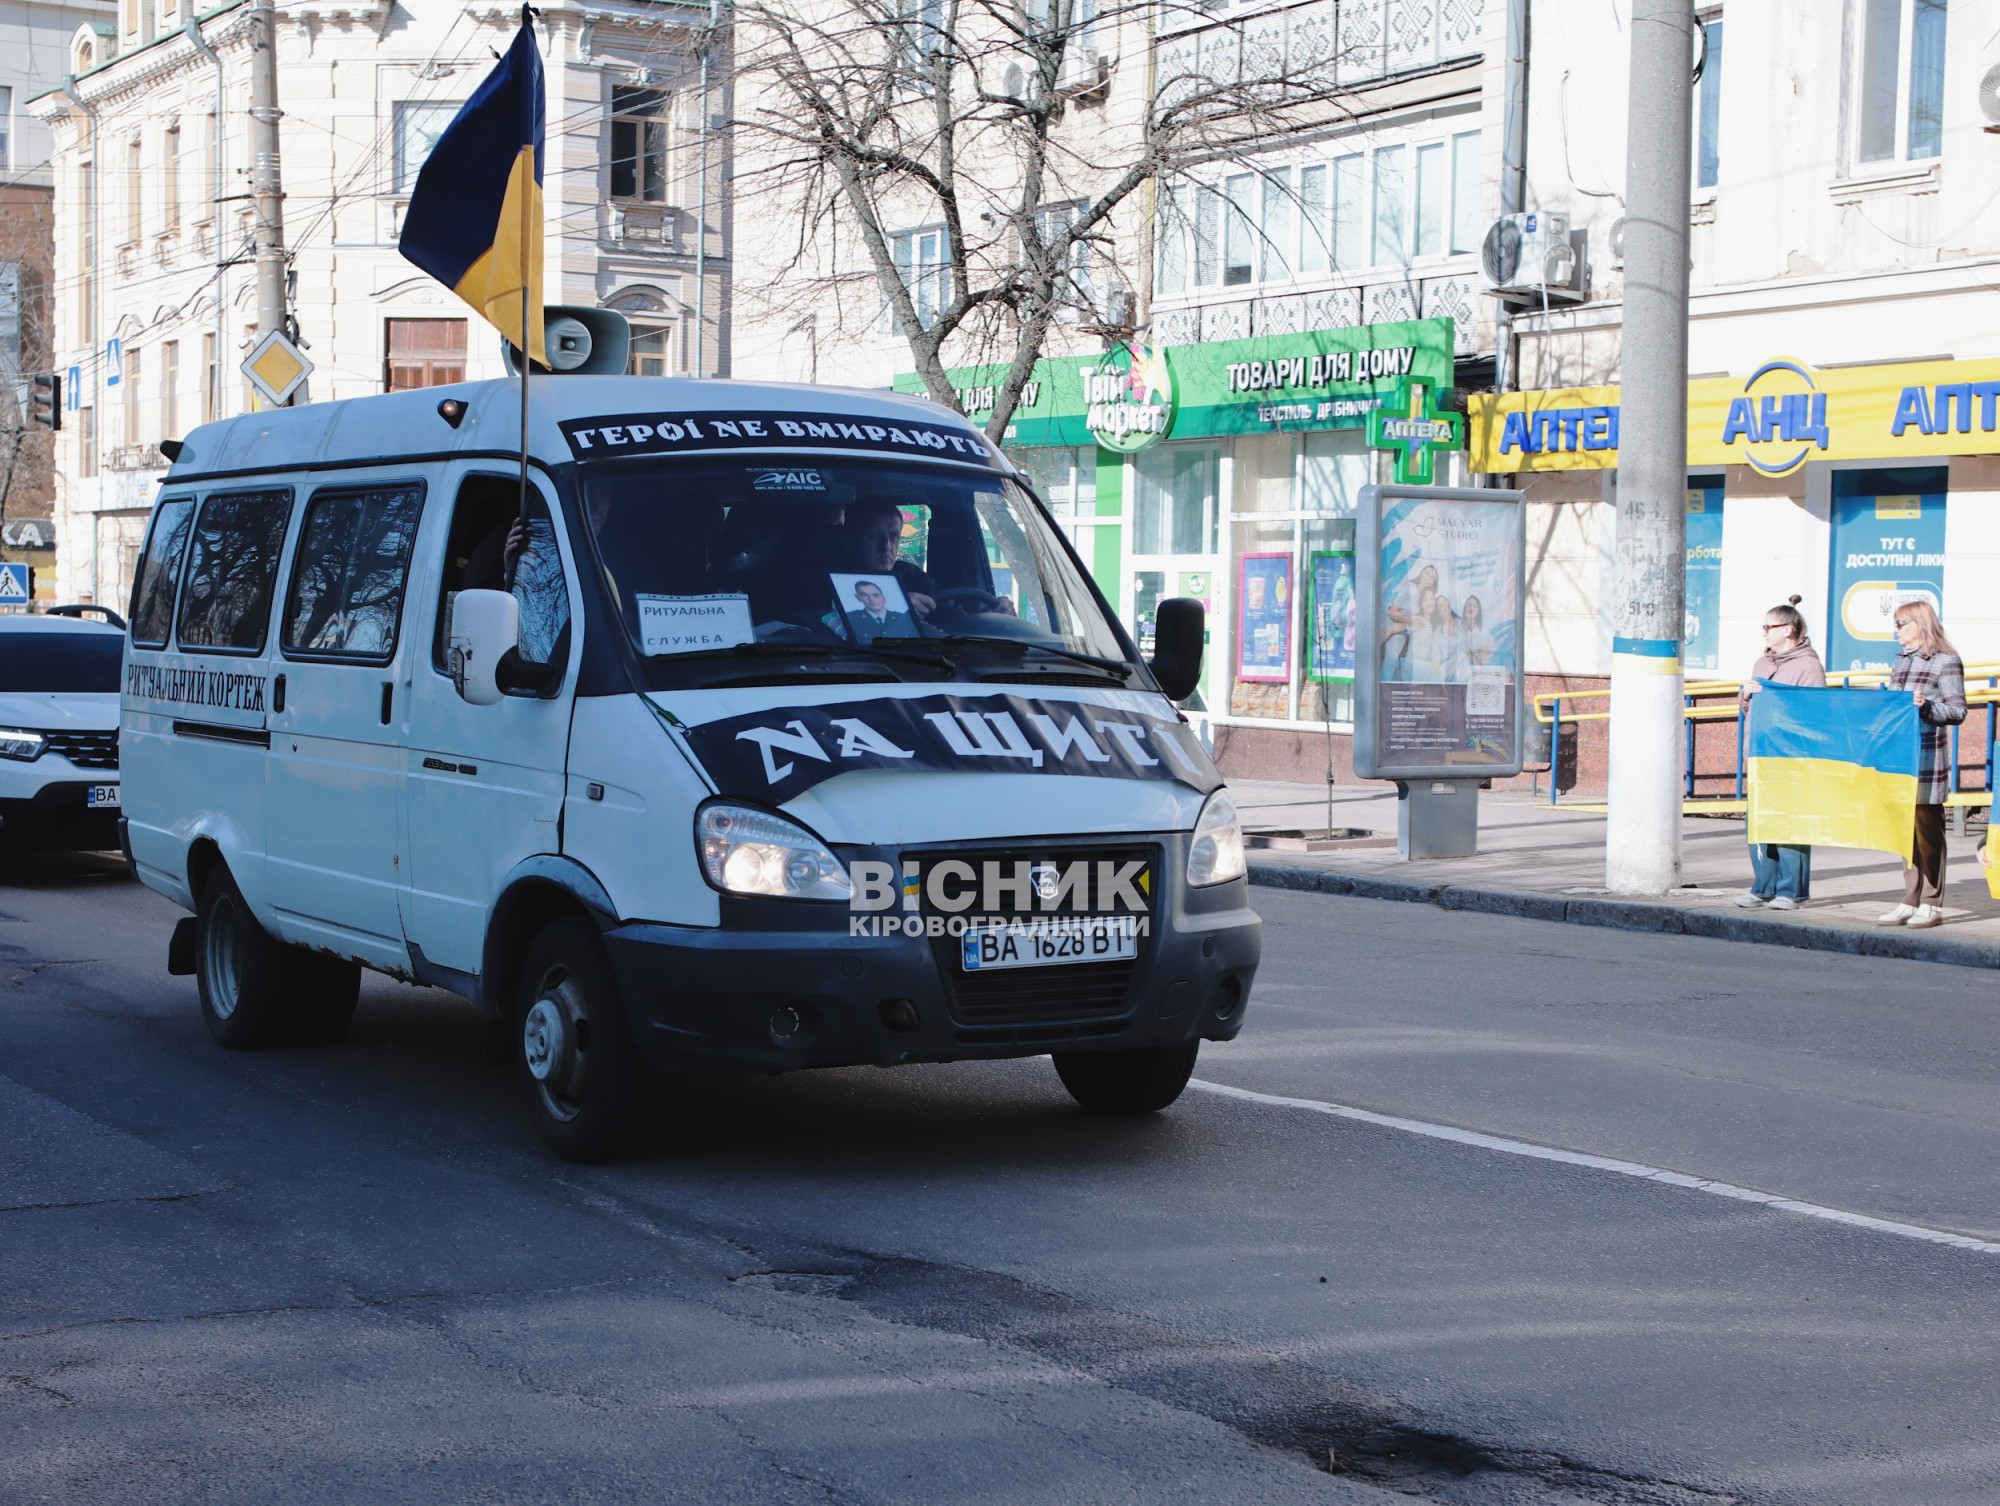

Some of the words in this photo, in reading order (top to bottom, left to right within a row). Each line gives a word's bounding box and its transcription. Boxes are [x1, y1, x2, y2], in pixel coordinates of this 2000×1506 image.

[1226, 357, 1304, 391] ТОВАРИ
[1309, 352, 1351, 387] ДЛЯ
[1356, 346, 1416, 383] ДОМУ
[1080, 364, 1125, 403] Твій
[1086, 402, 1162, 442] маркет
[1258, 404, 1312, 422] ТЕКСТИЛЬ
[1722, 392, 1829, 450] АНЦ
[572, 418, 704, 449] ГЕРОЇ
[774, 420, 993, 458] ВМИРАЮТЬ
[1384, 420, 1453, 440] АПТЕКА
[785, 472, 822, 485] AIC
[1440, 531, 1478, 540] STUDIO
[1880, 537, 1904, 550] ТУТ
[1906, 537, 1916, 550] Є
[1846, 553, 1913, 568] ДОСТУПНІ
[644, 606, 725, 616] РИТУАЛЬНА
[126, 664, 206, 705] РИТУАЛЬНИЙ
[207, 671, 266, 712] КОРТЕЖ
[924, 711, 1203, 777] ЩИТІ
[96, 788, 116, 801] BA
[966, 954, 978, 964] UA
[982, 933, 1019, 962] BA
[1028, 926, 1085, 959] 1628
